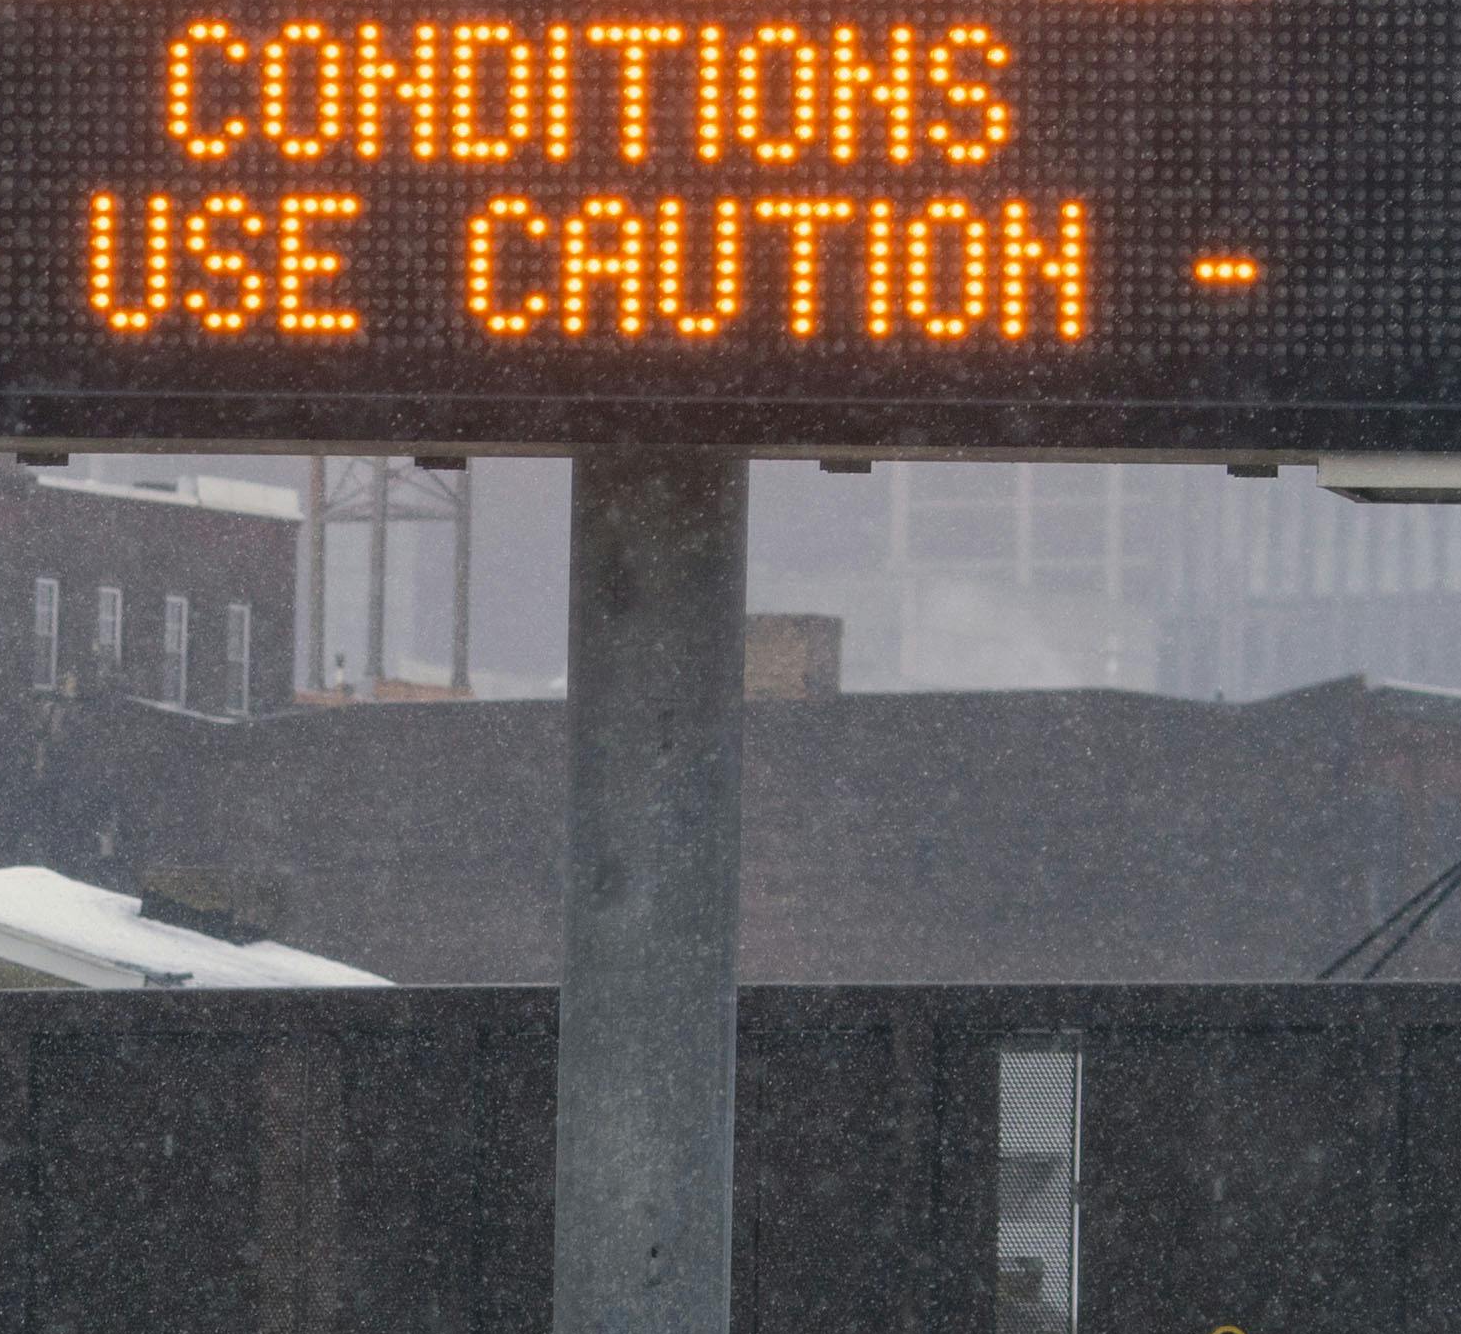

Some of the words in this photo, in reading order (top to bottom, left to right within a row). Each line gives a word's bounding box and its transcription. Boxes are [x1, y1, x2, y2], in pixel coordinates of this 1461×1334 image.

[166, 18, 1011, 167] CONDITIONS
[88, 192, 362, 334] USE
[466, 194, 1087, 341] CAUTION
